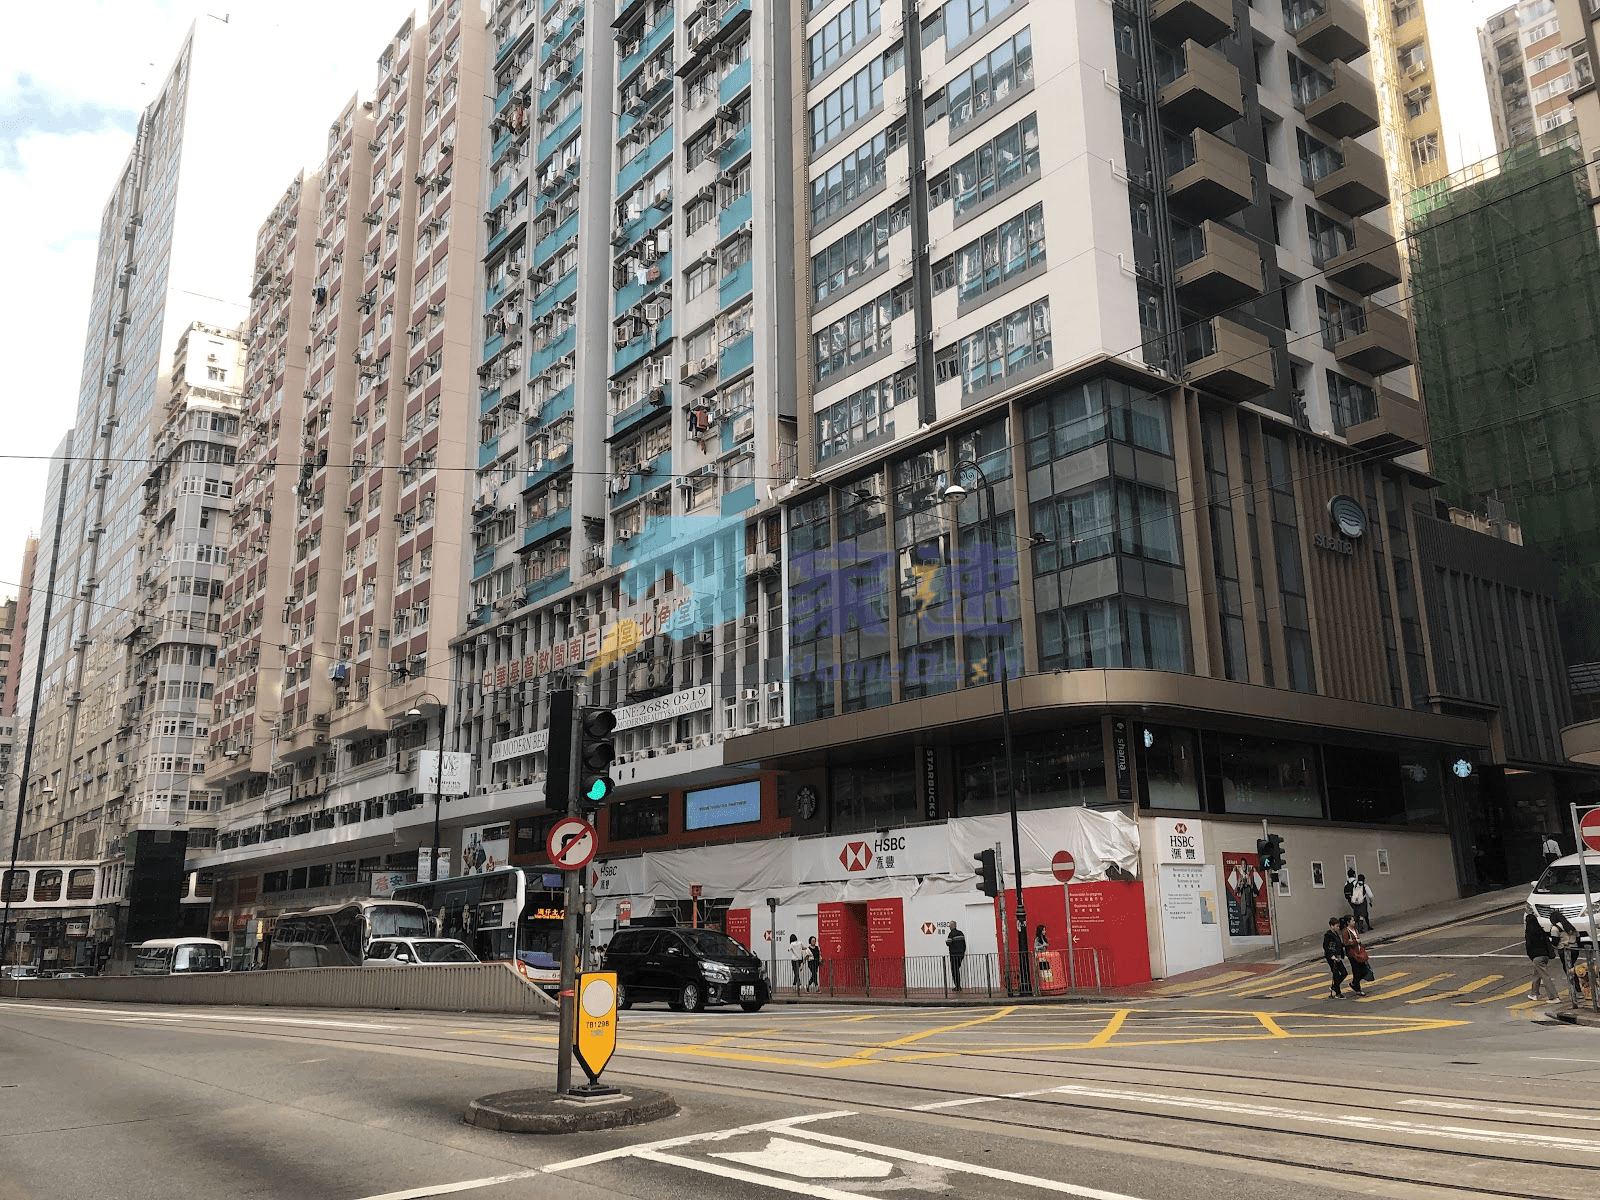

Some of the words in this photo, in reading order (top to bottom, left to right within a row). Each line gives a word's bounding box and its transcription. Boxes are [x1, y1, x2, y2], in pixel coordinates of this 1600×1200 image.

[673, 687, 706, 707] 0919
[502, 736, 532, 757] MODERN
[1117, 738, 1126, 771] shama
[926, 749, 936, 818] STARBUCKS
[874, 836, 906, 852] HSBC
[1169, 835, 1195, 848] HSBC
[600, 865, 618, 877] HSBC
